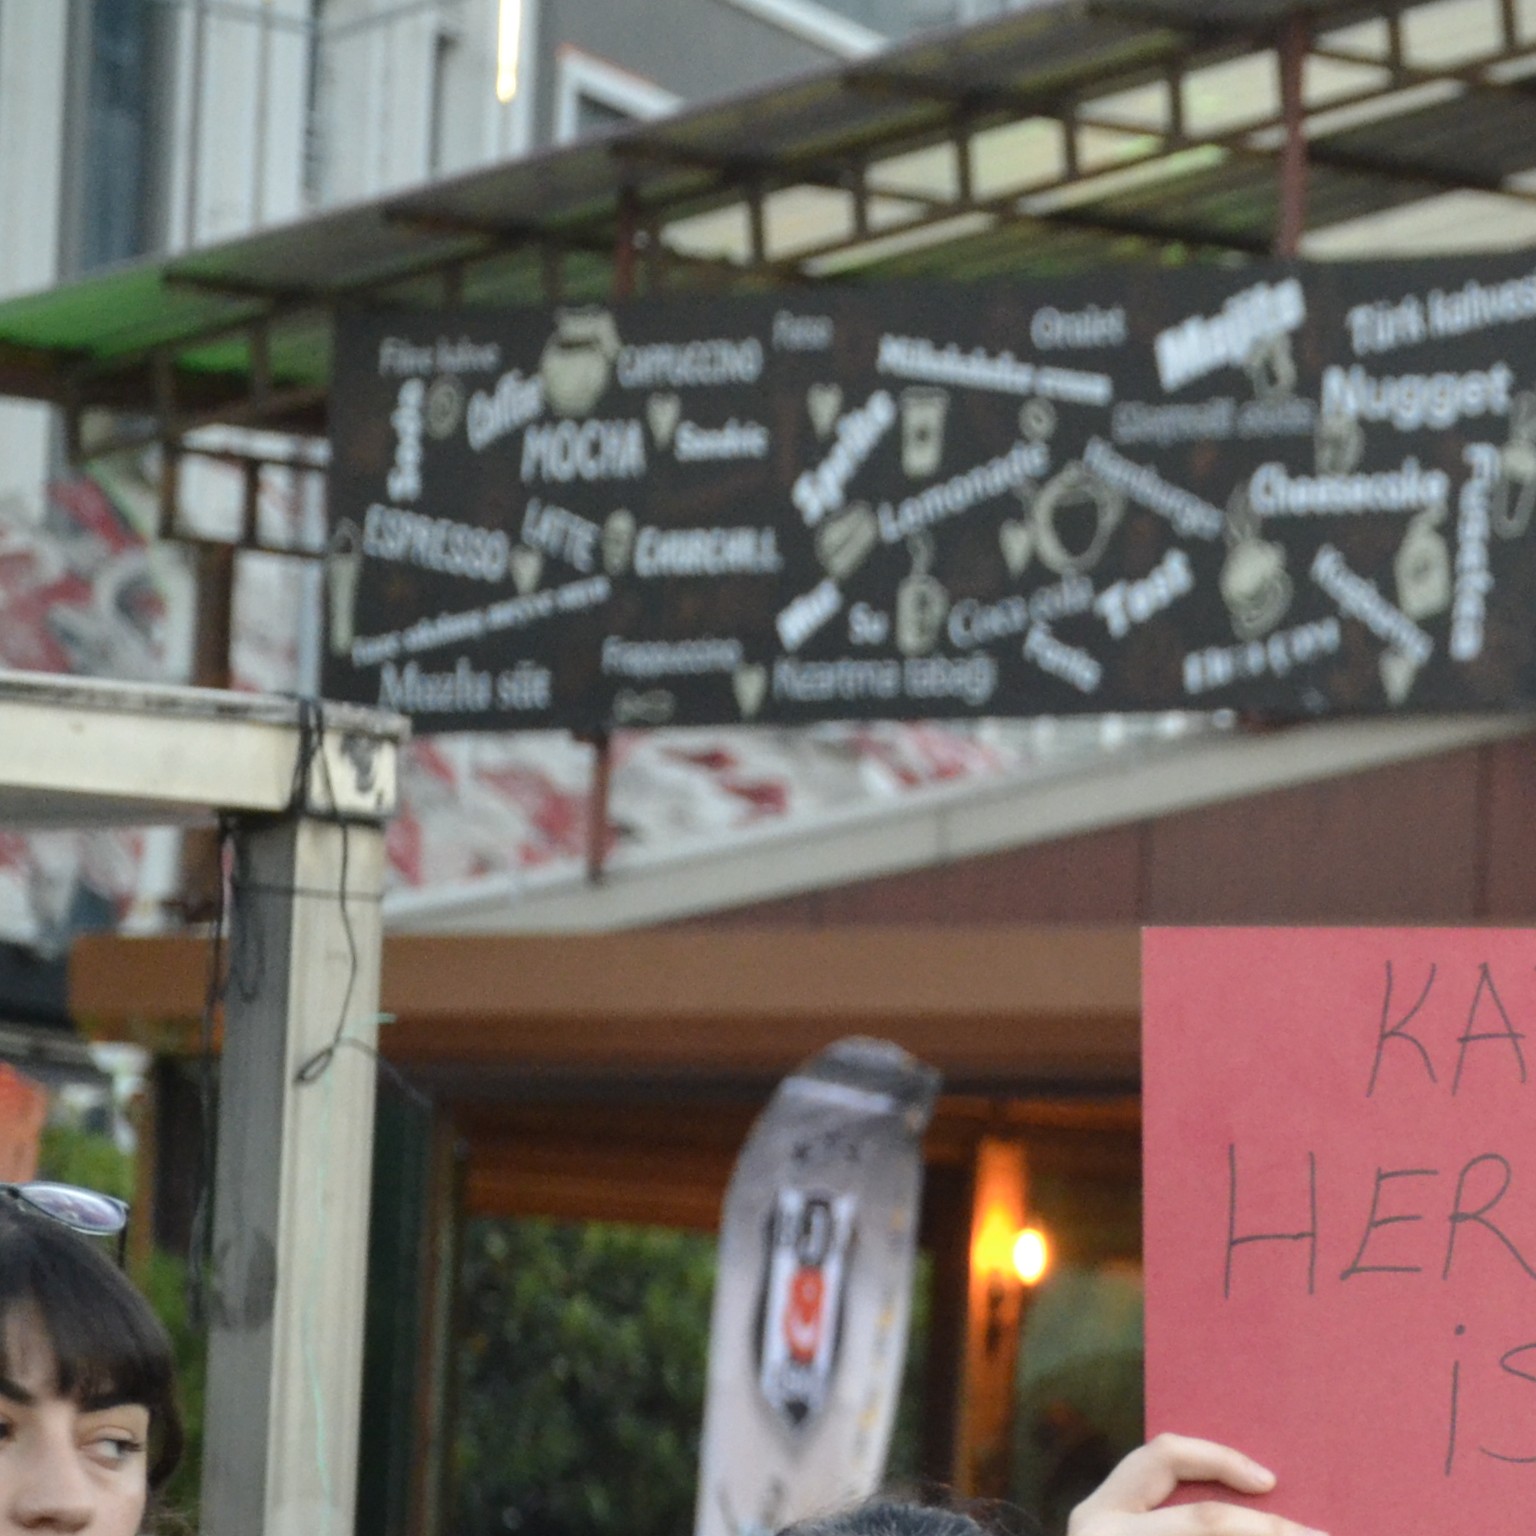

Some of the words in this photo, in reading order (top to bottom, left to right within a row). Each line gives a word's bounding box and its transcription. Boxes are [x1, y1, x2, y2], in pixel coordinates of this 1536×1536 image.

[1350, 298, 1425, 354] Türk
[468, 371, 545, 448] Coffee
[1322, 364, 1513, 430] Nugget
[520, 418, 645, 482] MOCHA
[878, 440, 1048, 543] Lemonade
[1251, 463, 1449, 515] Cheesecake
[363, 502, 508, 583] ESPRESSO
[522, 500, 601, 574] LATTE
[849, 603, 888, 643] Su
[1095, 551, 1191, 634] Tost
[380, 660, 490, 714] Muzlu
[497, 661, 550, 708] süt
